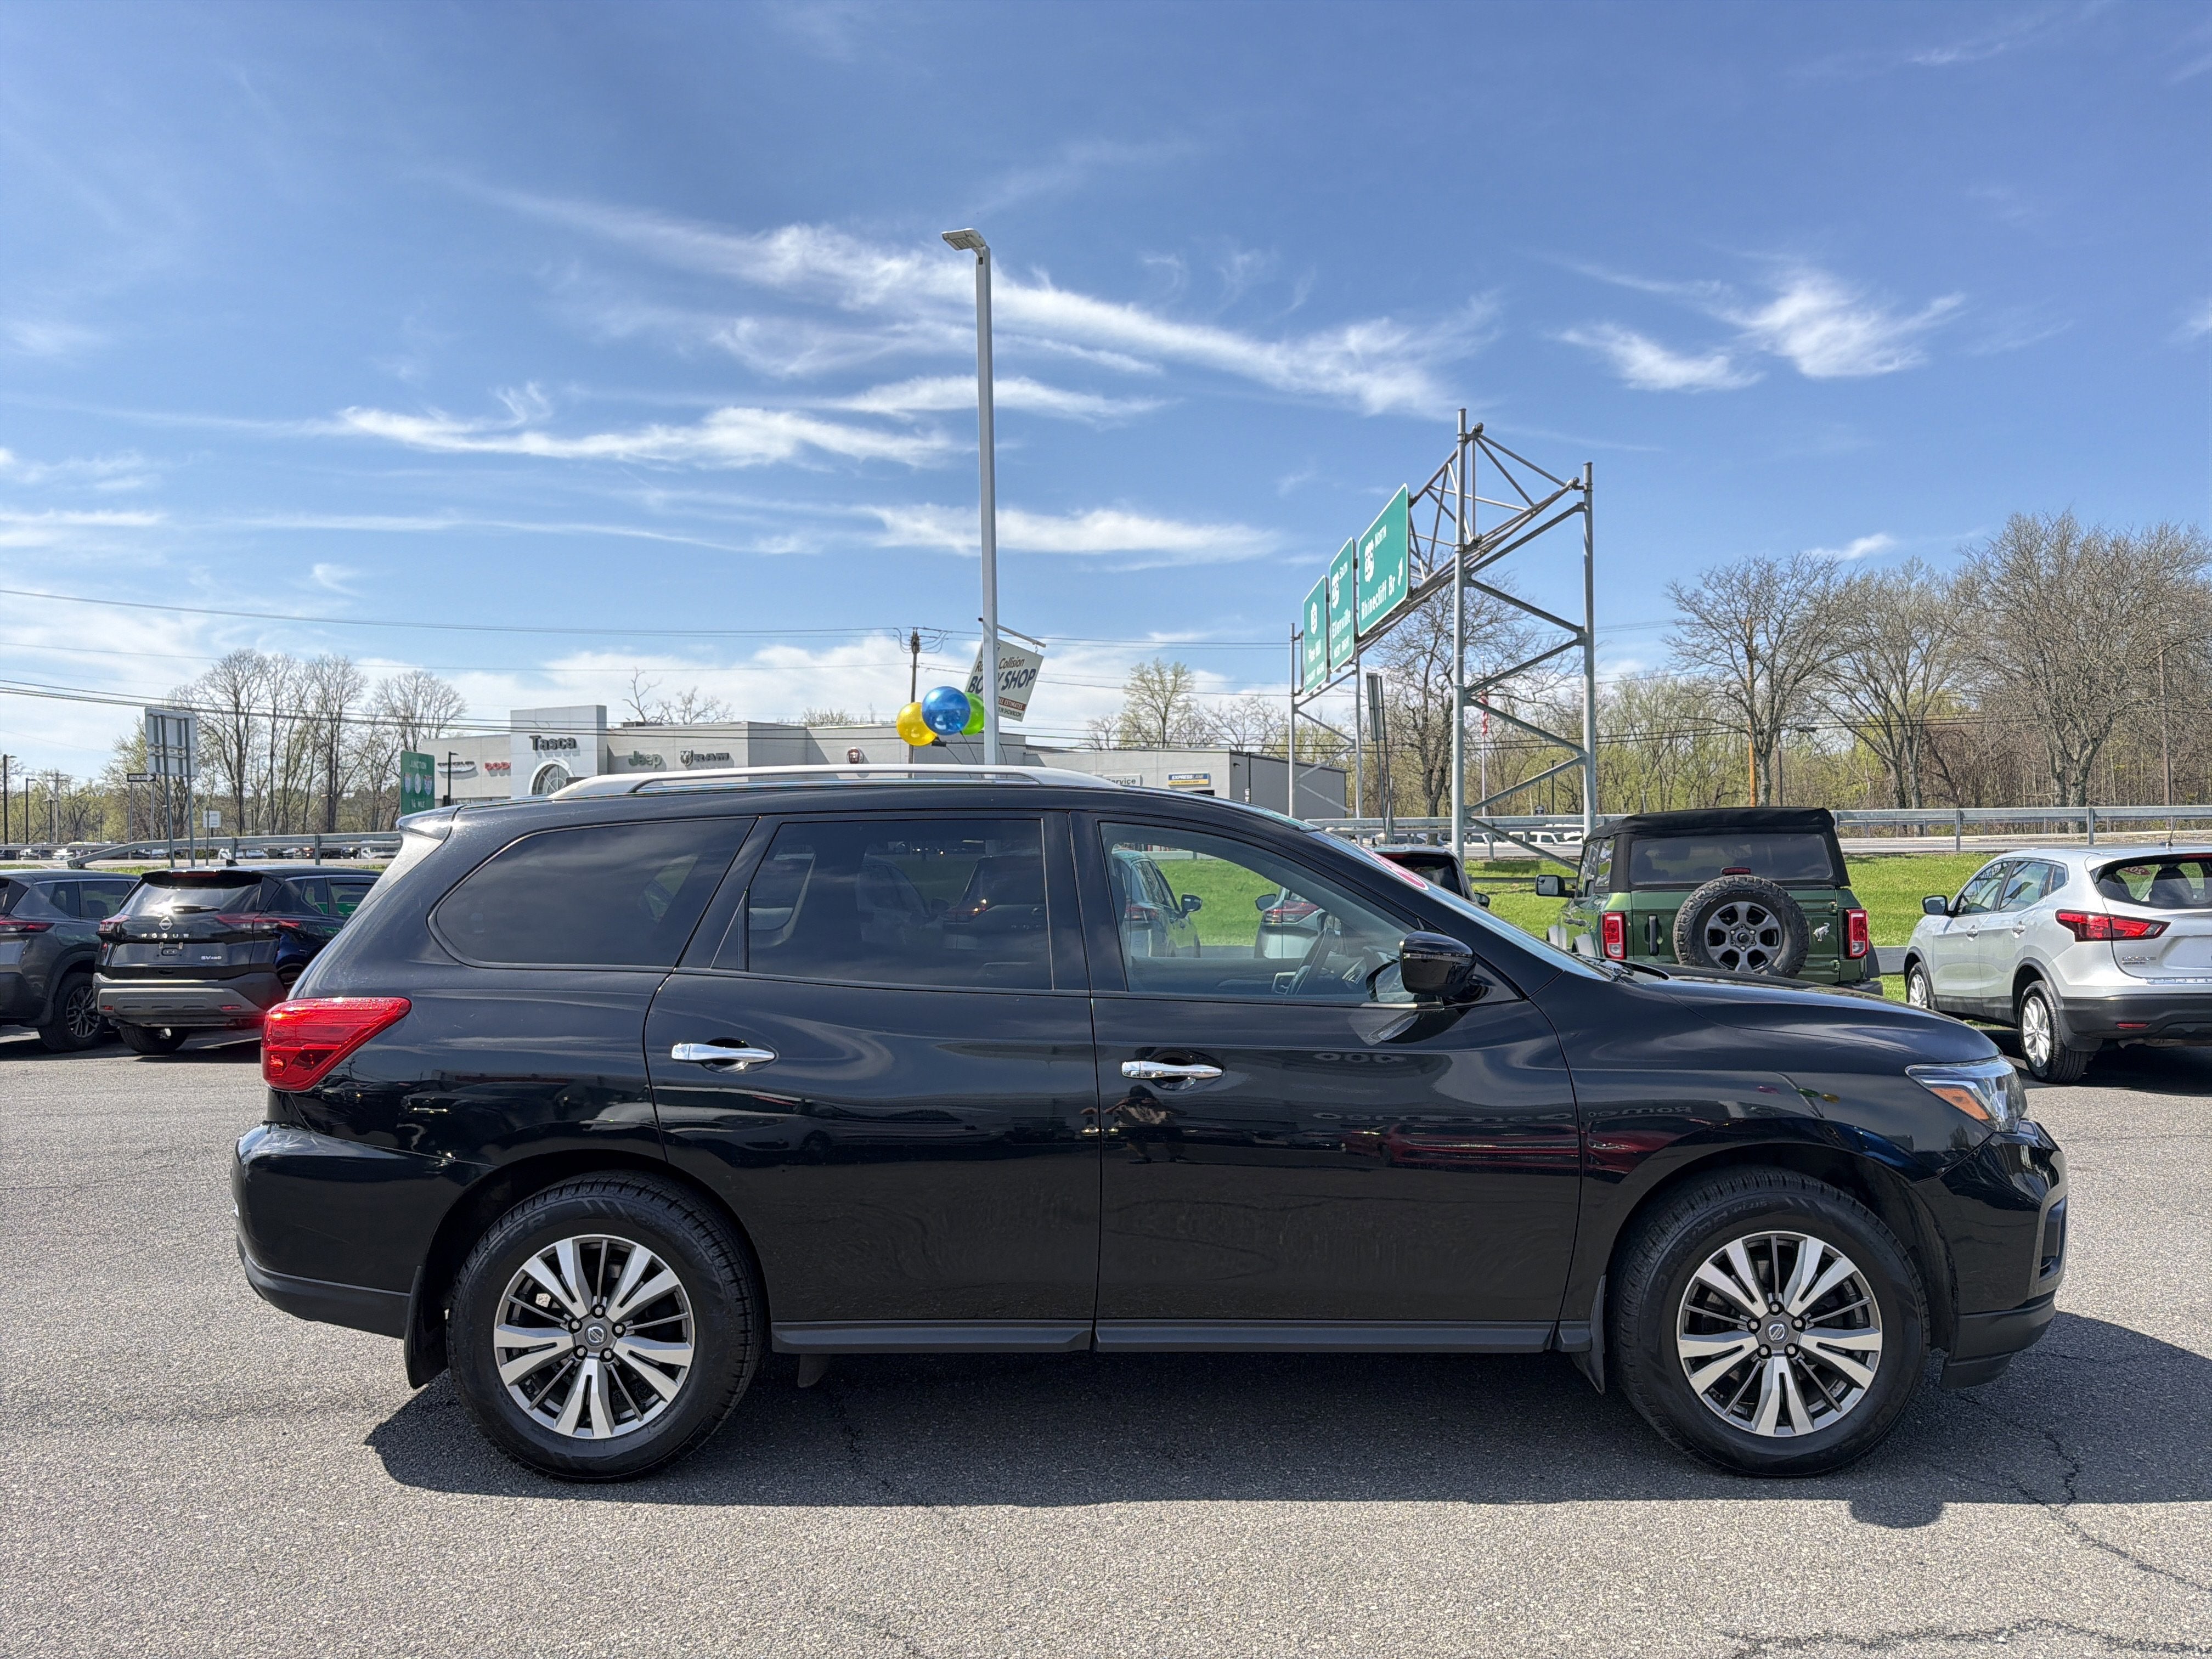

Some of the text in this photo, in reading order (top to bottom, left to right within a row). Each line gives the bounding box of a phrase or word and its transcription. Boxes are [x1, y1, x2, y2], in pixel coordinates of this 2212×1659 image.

[1362, 574, 1396, 621] Rhinecliff Br
[998, 657, 1025, 669] Collision
[1001, 668, 1036, 691] SHOP
[1004, 699, 1023, 709] ESTIMATES
[529, 735, 577, 751] Tasca
[628, 751, 662, 768] Jeep
[694, 752, 730, 761] RAM
